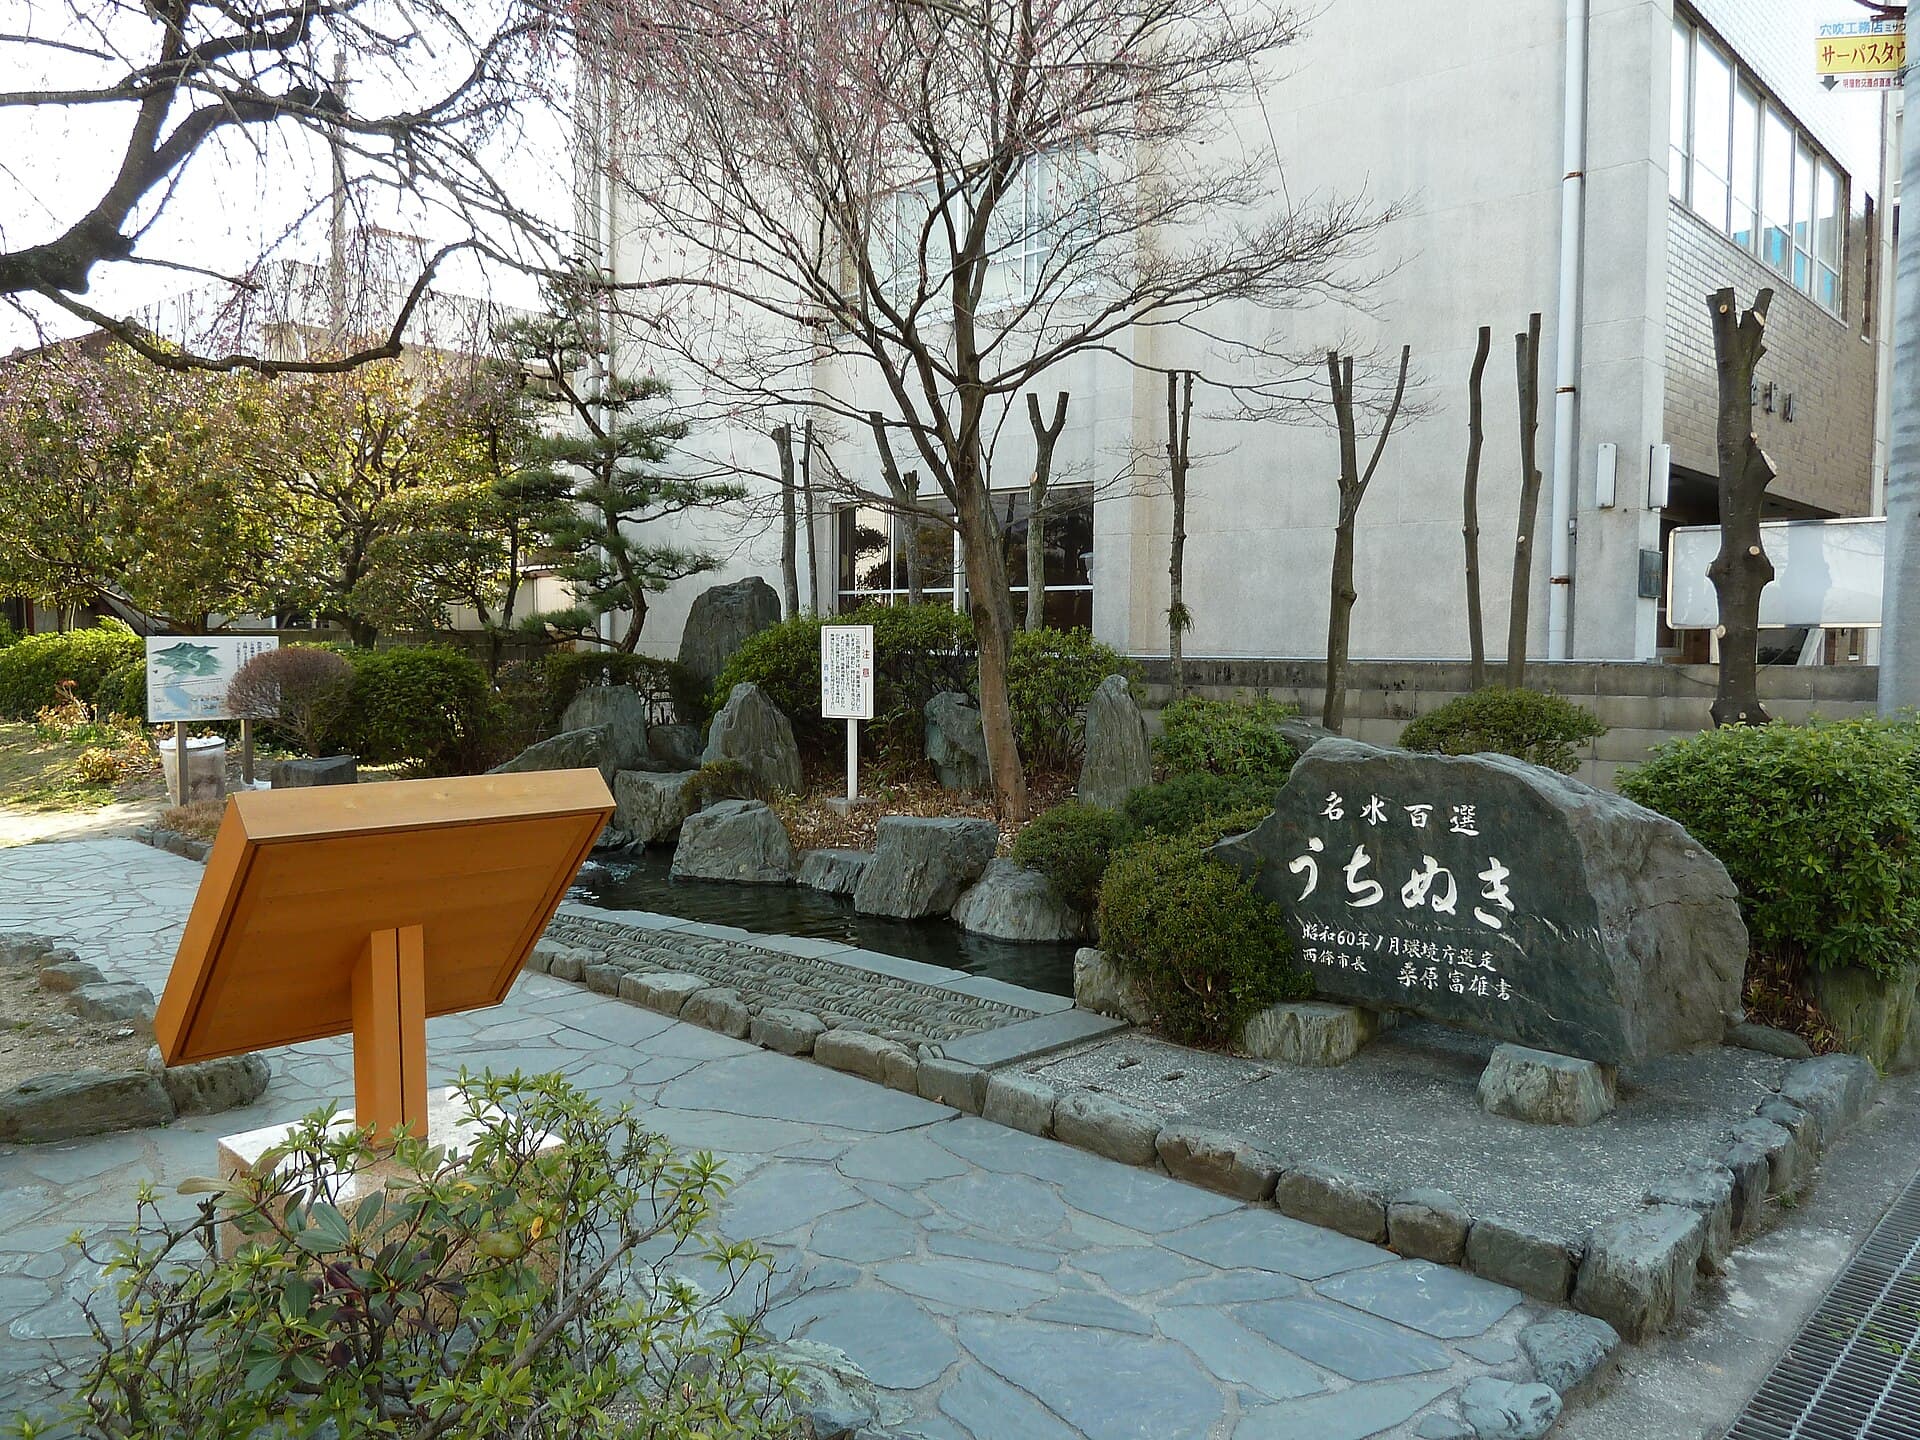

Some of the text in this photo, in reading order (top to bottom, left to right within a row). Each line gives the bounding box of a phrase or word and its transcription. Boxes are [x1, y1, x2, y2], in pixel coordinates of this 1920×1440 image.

[1319, 791, 1480, 837] 名水百選
[1288, 836, 1515, 930] うちぬき
